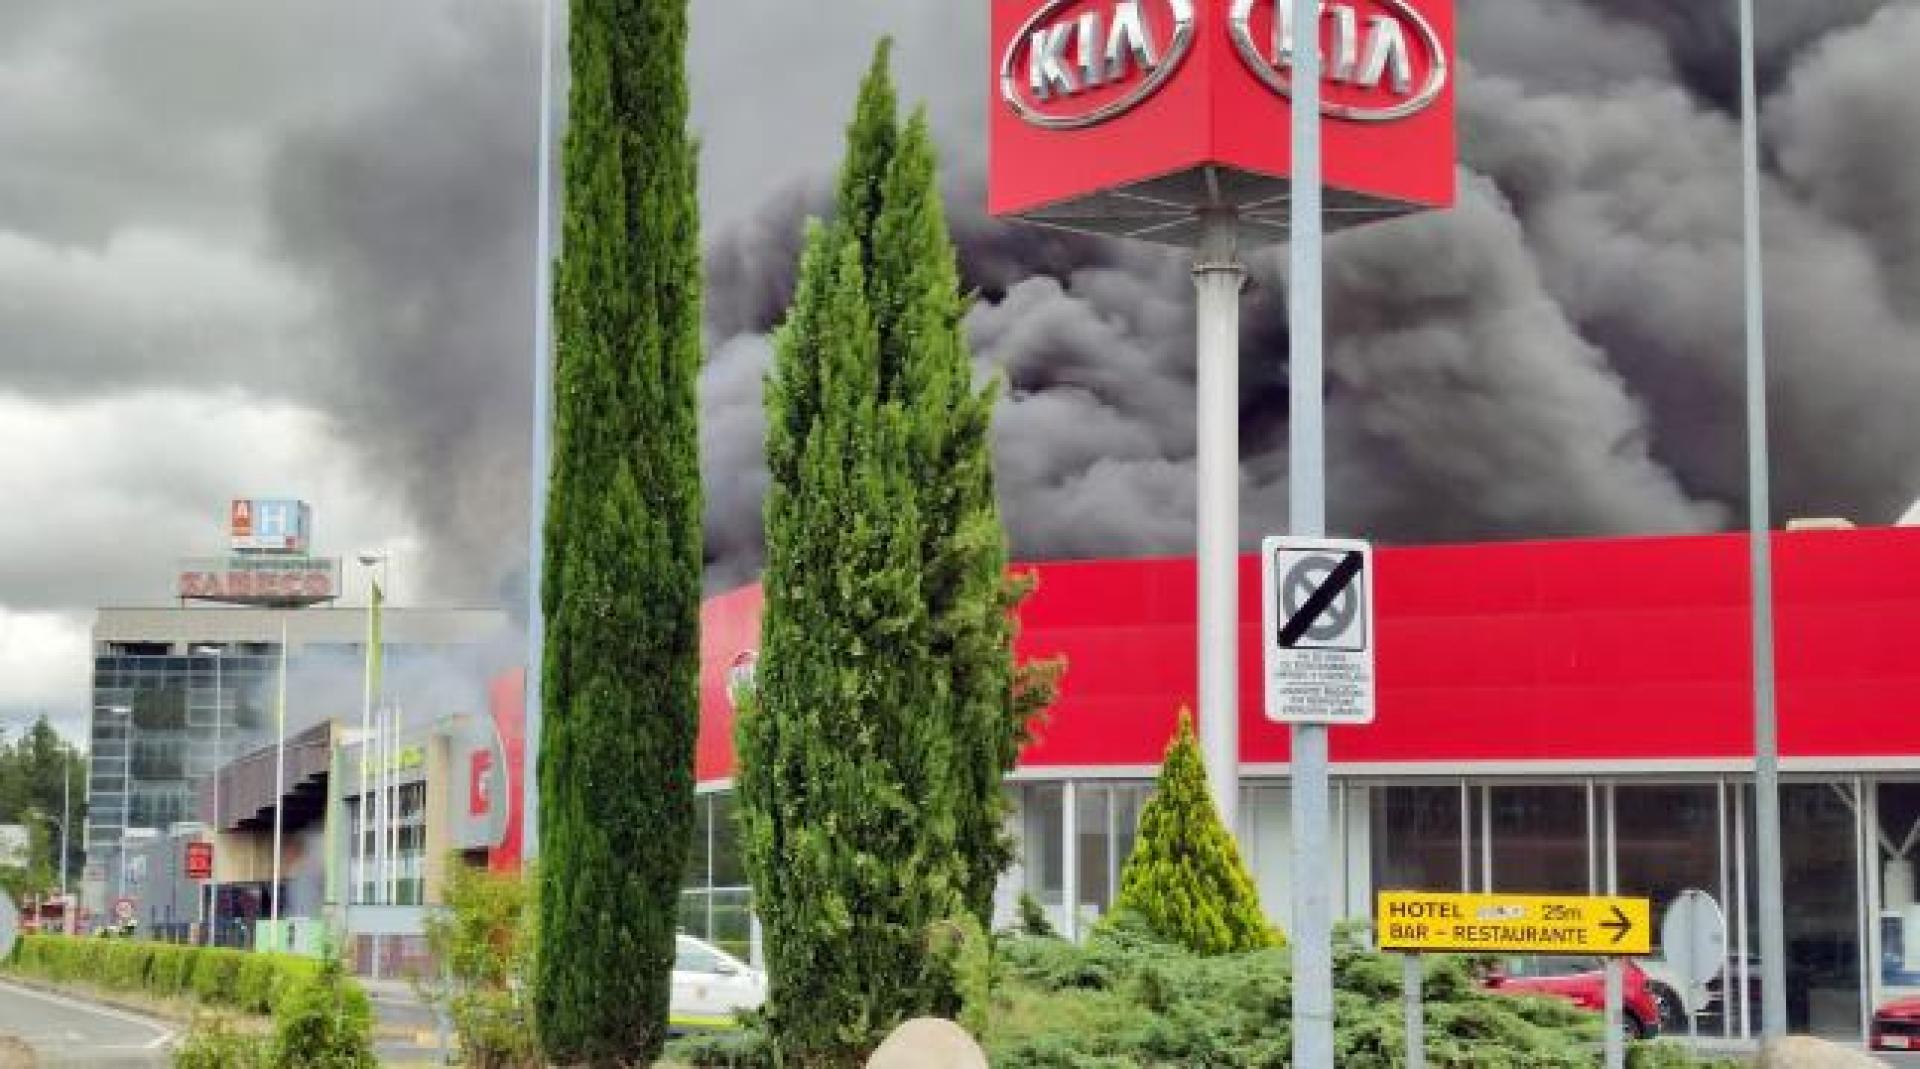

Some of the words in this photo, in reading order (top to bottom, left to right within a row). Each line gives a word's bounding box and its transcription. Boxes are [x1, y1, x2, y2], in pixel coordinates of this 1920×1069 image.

[1028, 1, 1157, 101] KIA
[261, 504, 287, 536] H
[1389, 901, 1464, 918] HOTEL
[1541, 904, 1582, 921] 25m
[1389, 923, 1429, 940] BAR
[1453, 925, 1588, 944] RESTAURANTE
